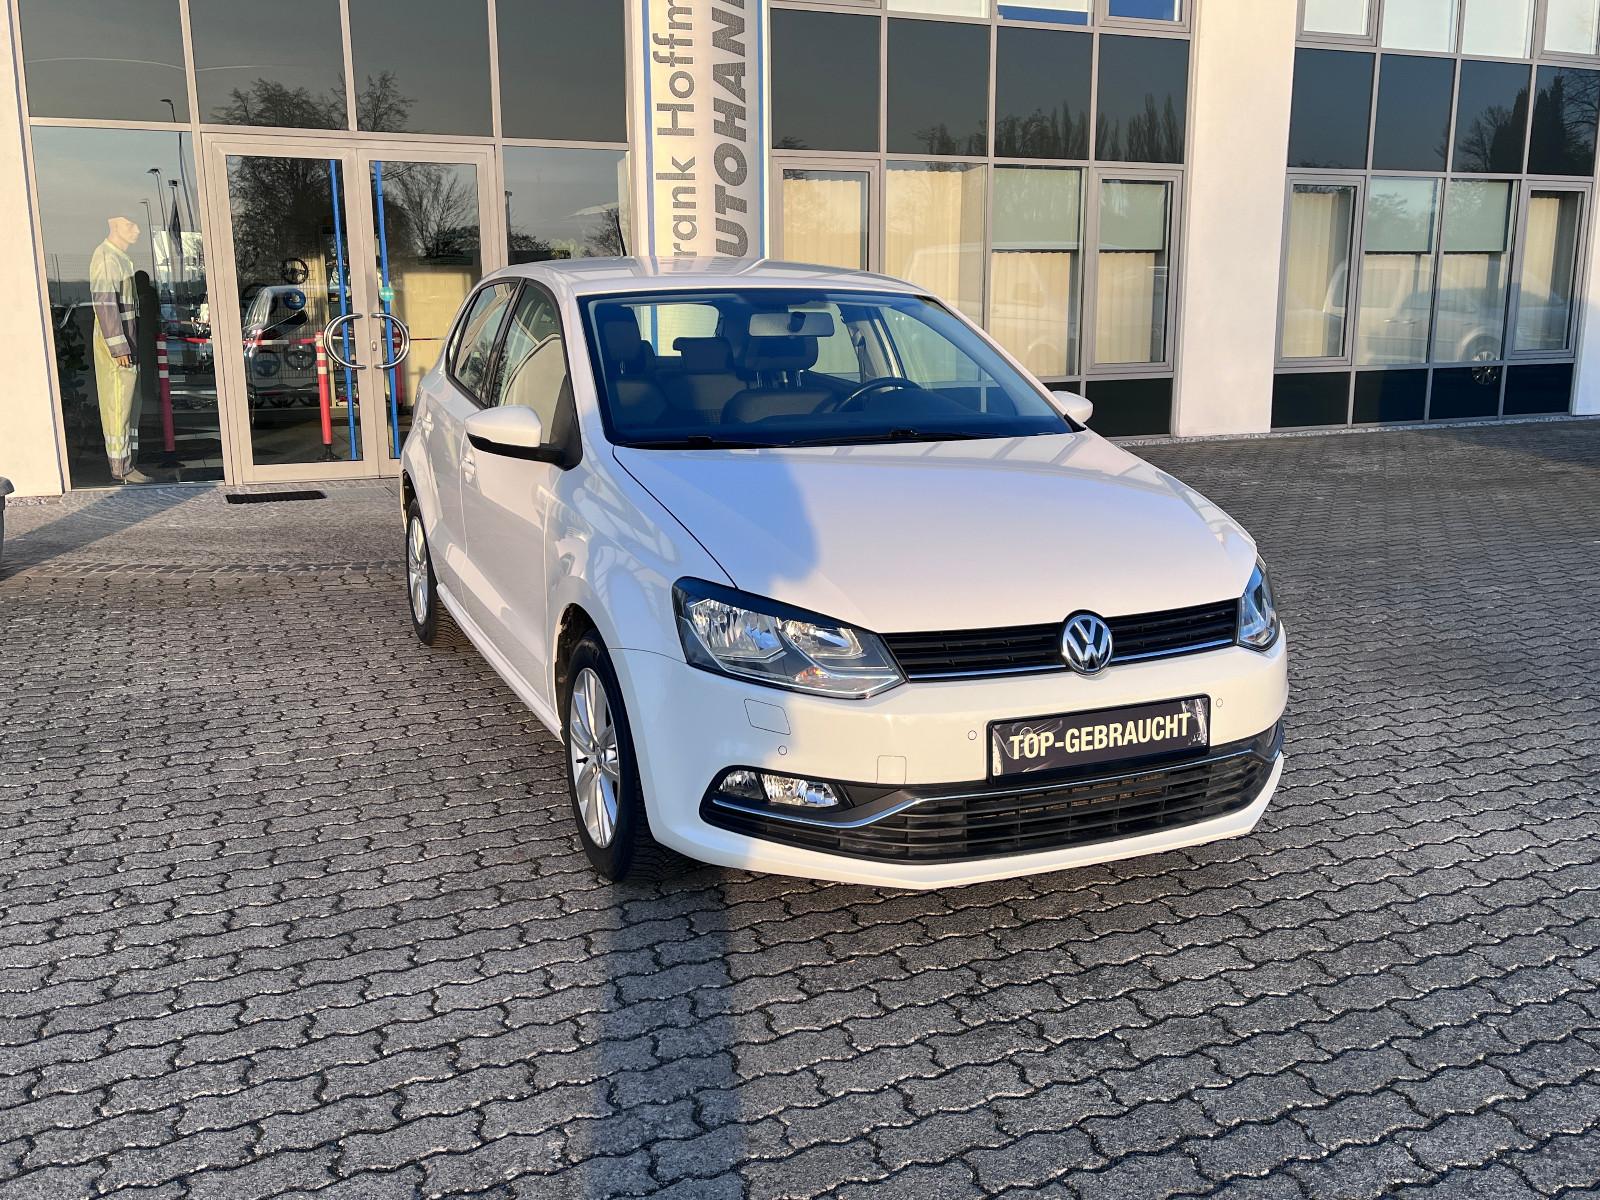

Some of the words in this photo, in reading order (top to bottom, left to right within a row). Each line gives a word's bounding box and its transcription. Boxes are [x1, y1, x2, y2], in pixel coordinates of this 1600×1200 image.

[711, 0, 749, 258] UTOHAN
[655, 156, 698, 257] rank
[1061, 612, 1113, 673] VW
[1009, 711, 1192, 760] TOP-GEBRAUCHT
